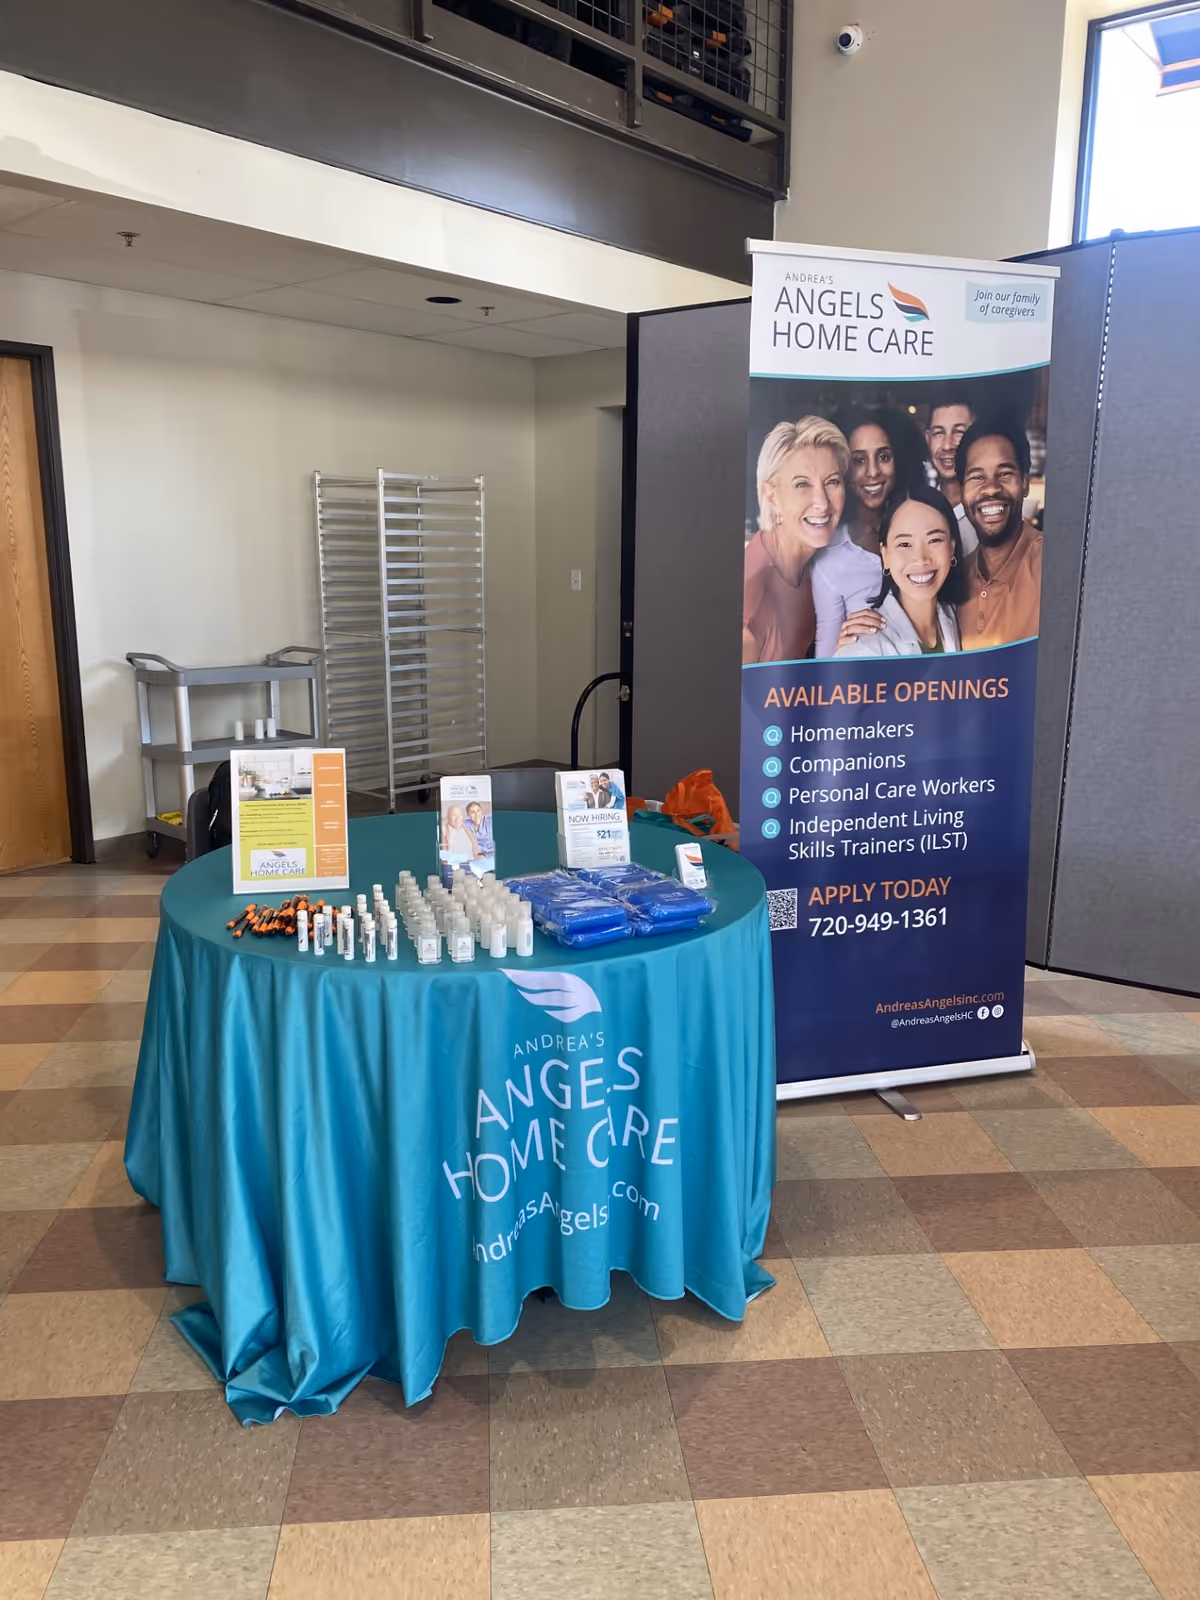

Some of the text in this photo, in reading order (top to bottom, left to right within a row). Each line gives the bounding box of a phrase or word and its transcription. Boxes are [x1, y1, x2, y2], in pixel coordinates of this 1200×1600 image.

[785, 272, 834, 285] ANDREA'S
[774, 286, 884, 320] ANGELS
[974, 290, 1040, 306] Join our family
[980, 303, 1036, 318] of caregivers
[773, 320, 934, 356] HOME CARE
[764, 678, 1010, 708] AVAILABLE OPENINGS
[790, 720, 914, 743] Homemakers
[790, 752, 906, 776] Companions
[789, 777, 996, 804] Personal Care Workers
[568, 814, 590, 824] NOW
[591, 812, 620, 822] HIRING
[790, 808, 964, 837] Independent Living
[788, 832, 968, 860] Skills Trainers (ILST)
[250, 868, 306, 877] HOME CARE
[260, 860, 298, 869] ANGELS
[808, 876, 952, 906] APPLY TODAY
[808, 907, 948, 937] 720-949-1361
[875, 992, 1004, 1014] AndreasAngelsinc.com
[890, 1010, 974, 1028] @AndreasAngelsHC
[514, 1032, 605, 1060] ANDREA'S
[476, 1046, 643, 1138] ANGES
[442, 1118, 566, 1202] HOME
